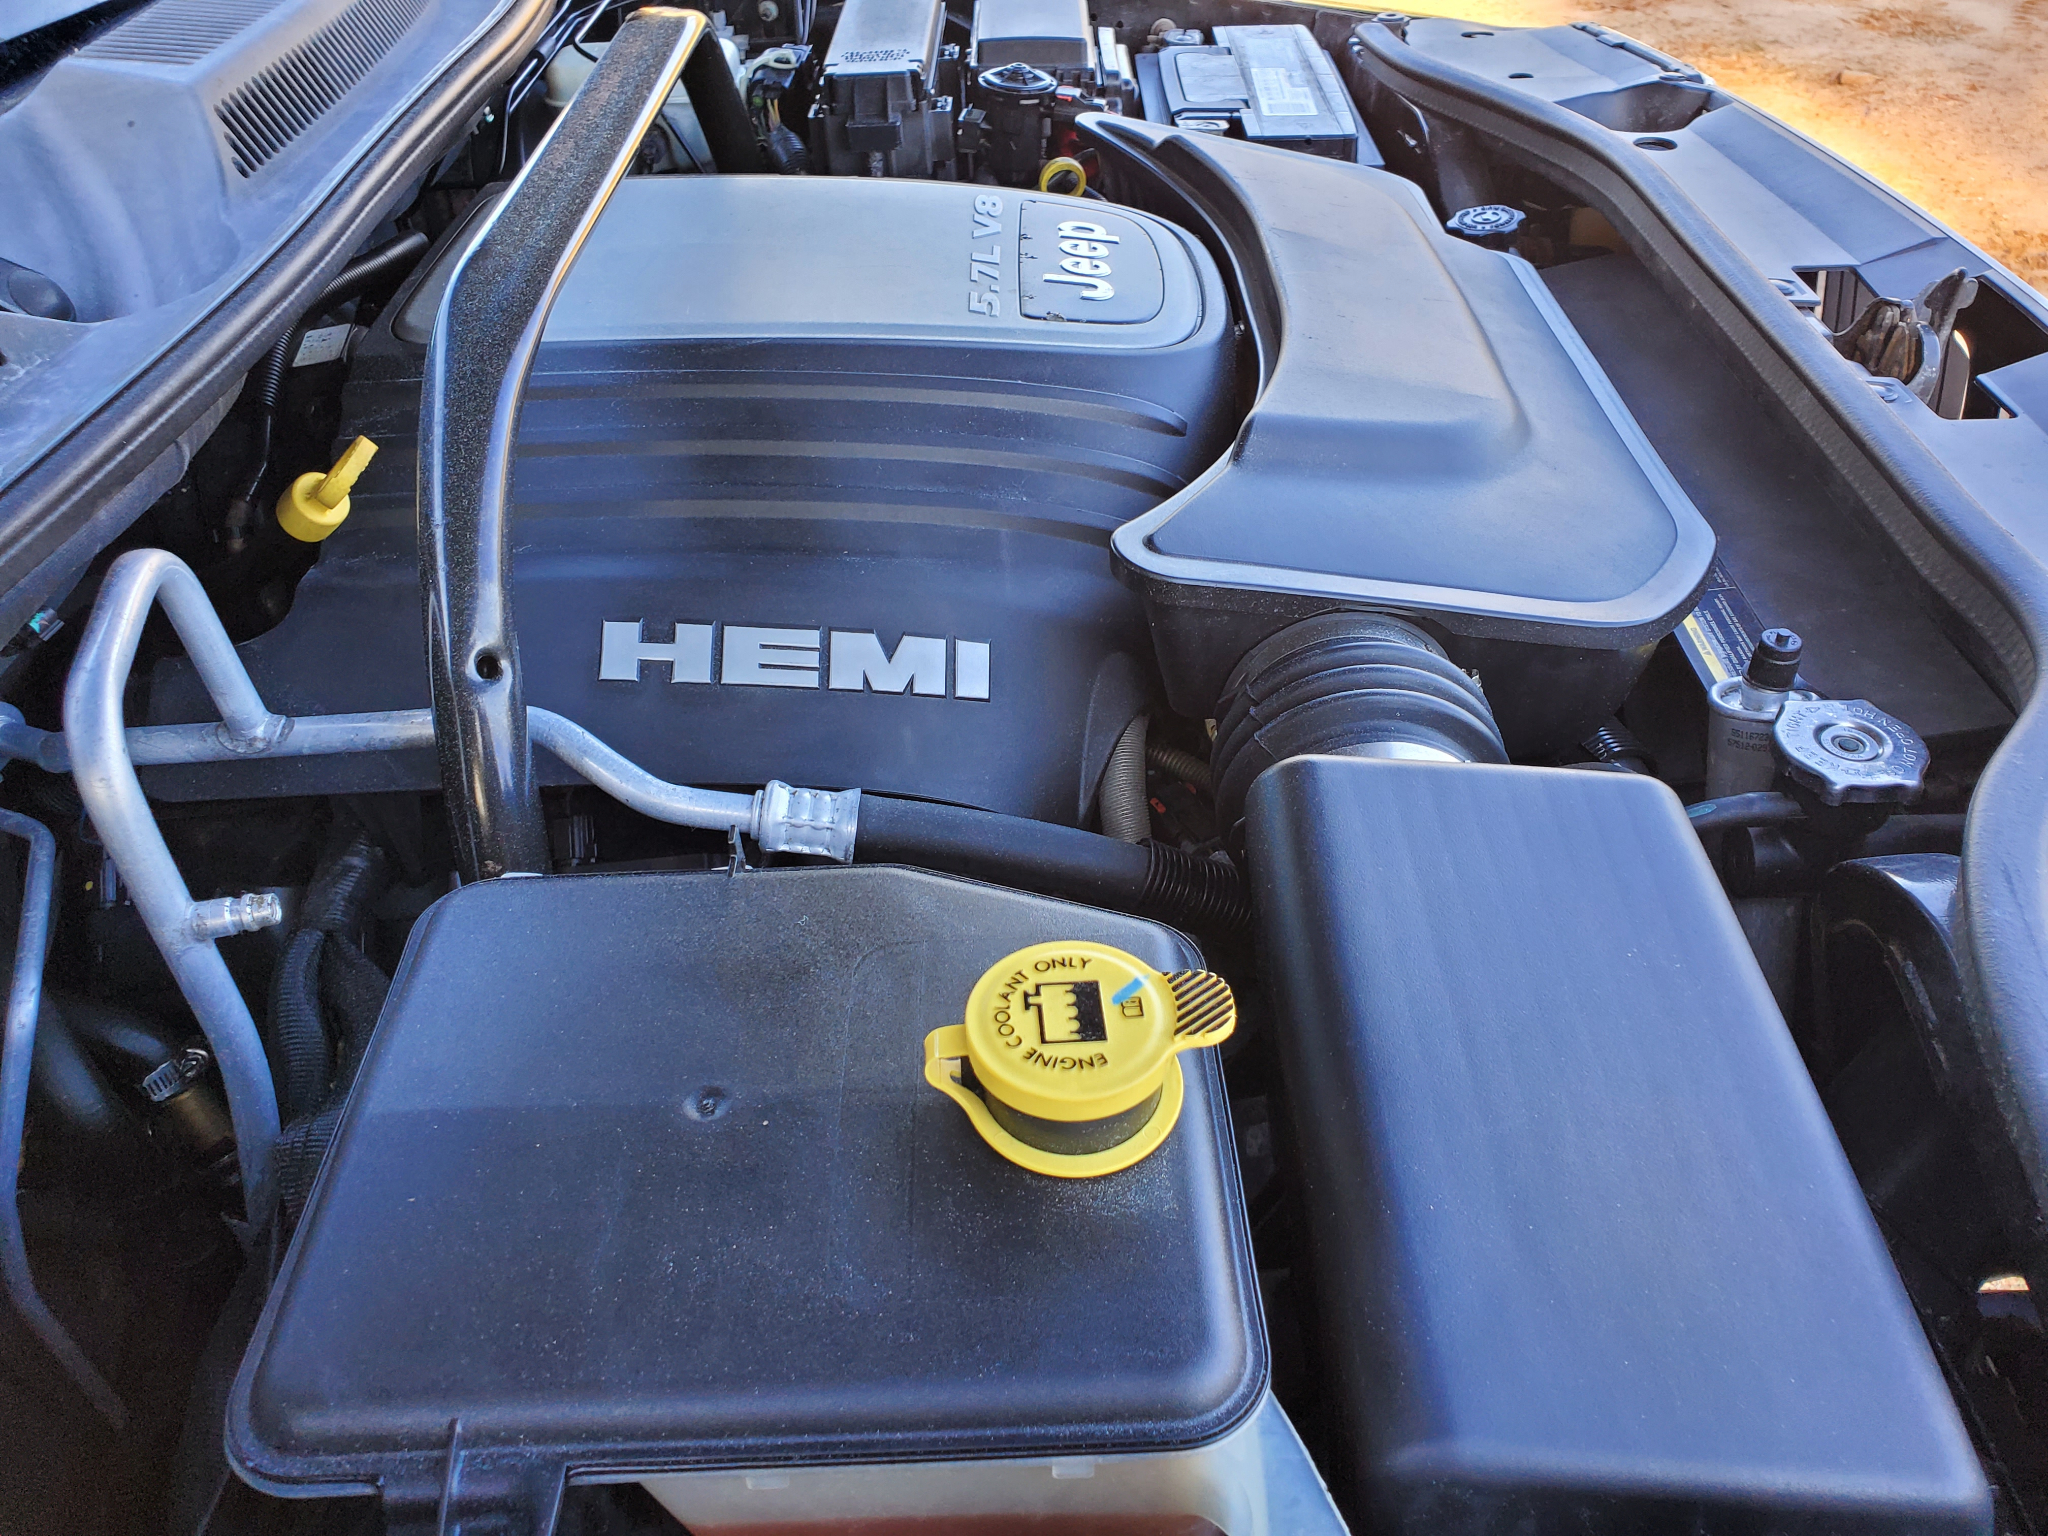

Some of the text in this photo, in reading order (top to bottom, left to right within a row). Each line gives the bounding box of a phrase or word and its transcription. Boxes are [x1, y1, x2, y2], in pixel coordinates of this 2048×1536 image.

[968, 194, 1004, 317] 5.7L V8
[1043, 220, 1121, 301] Jeep
[598, 618, 992, 702] HEMI
[1877, 717, 1914, 745] OPEN
[1901, 746, 1918, 768] NOT
[994, 957, 1108, 1070] ENGINE COOLANT ONLY
